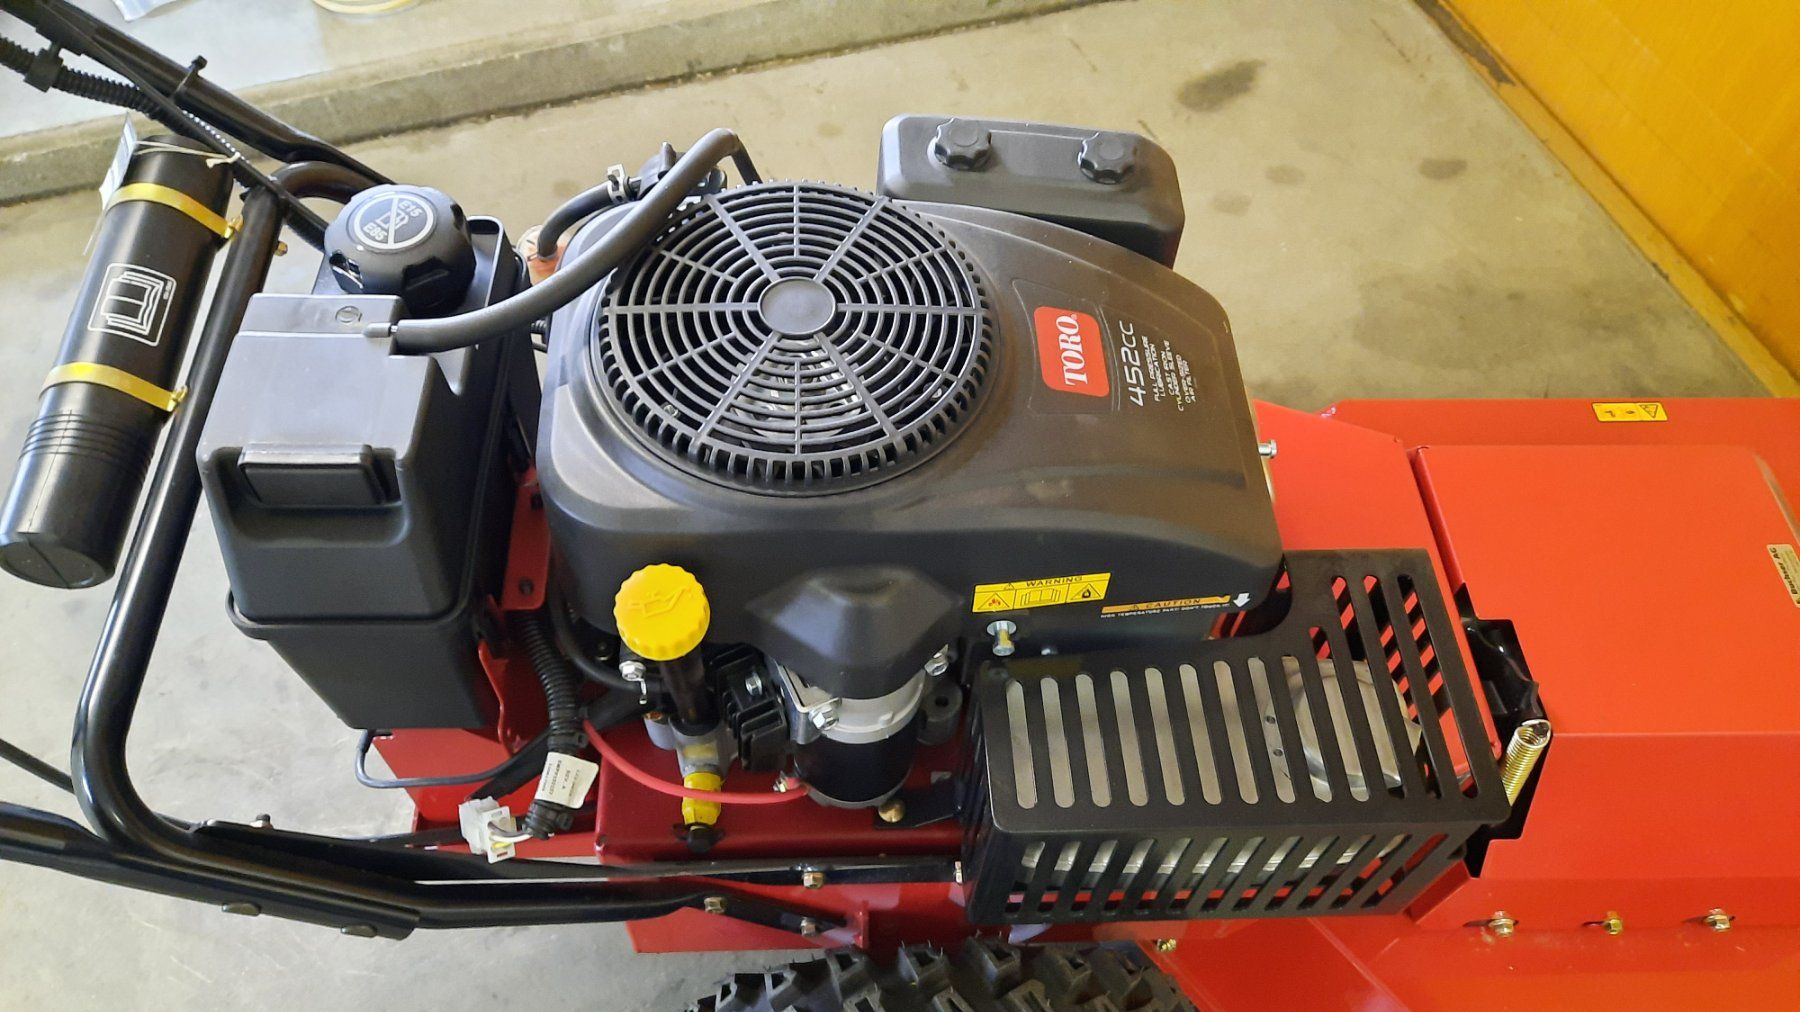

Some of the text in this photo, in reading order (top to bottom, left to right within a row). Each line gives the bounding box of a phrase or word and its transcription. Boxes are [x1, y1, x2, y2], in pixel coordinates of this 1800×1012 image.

[362, 222, 388, 241] E85
[399, 201, 423, 217] E15
[1056, 314, 1088, 386] TORO
[1141, 335, 1161, 402] FULL PRESSURE
[1149, 343, 1166, 397] LUBRICATION
[1161, 350, 1174, 396] CAST IRON
[1163, 340, 1184, 412] CYLINDER SLEEVE
[1026, 576, 1083, 588] WARNING
[1145, 598, 1201, 609] CAUTION
